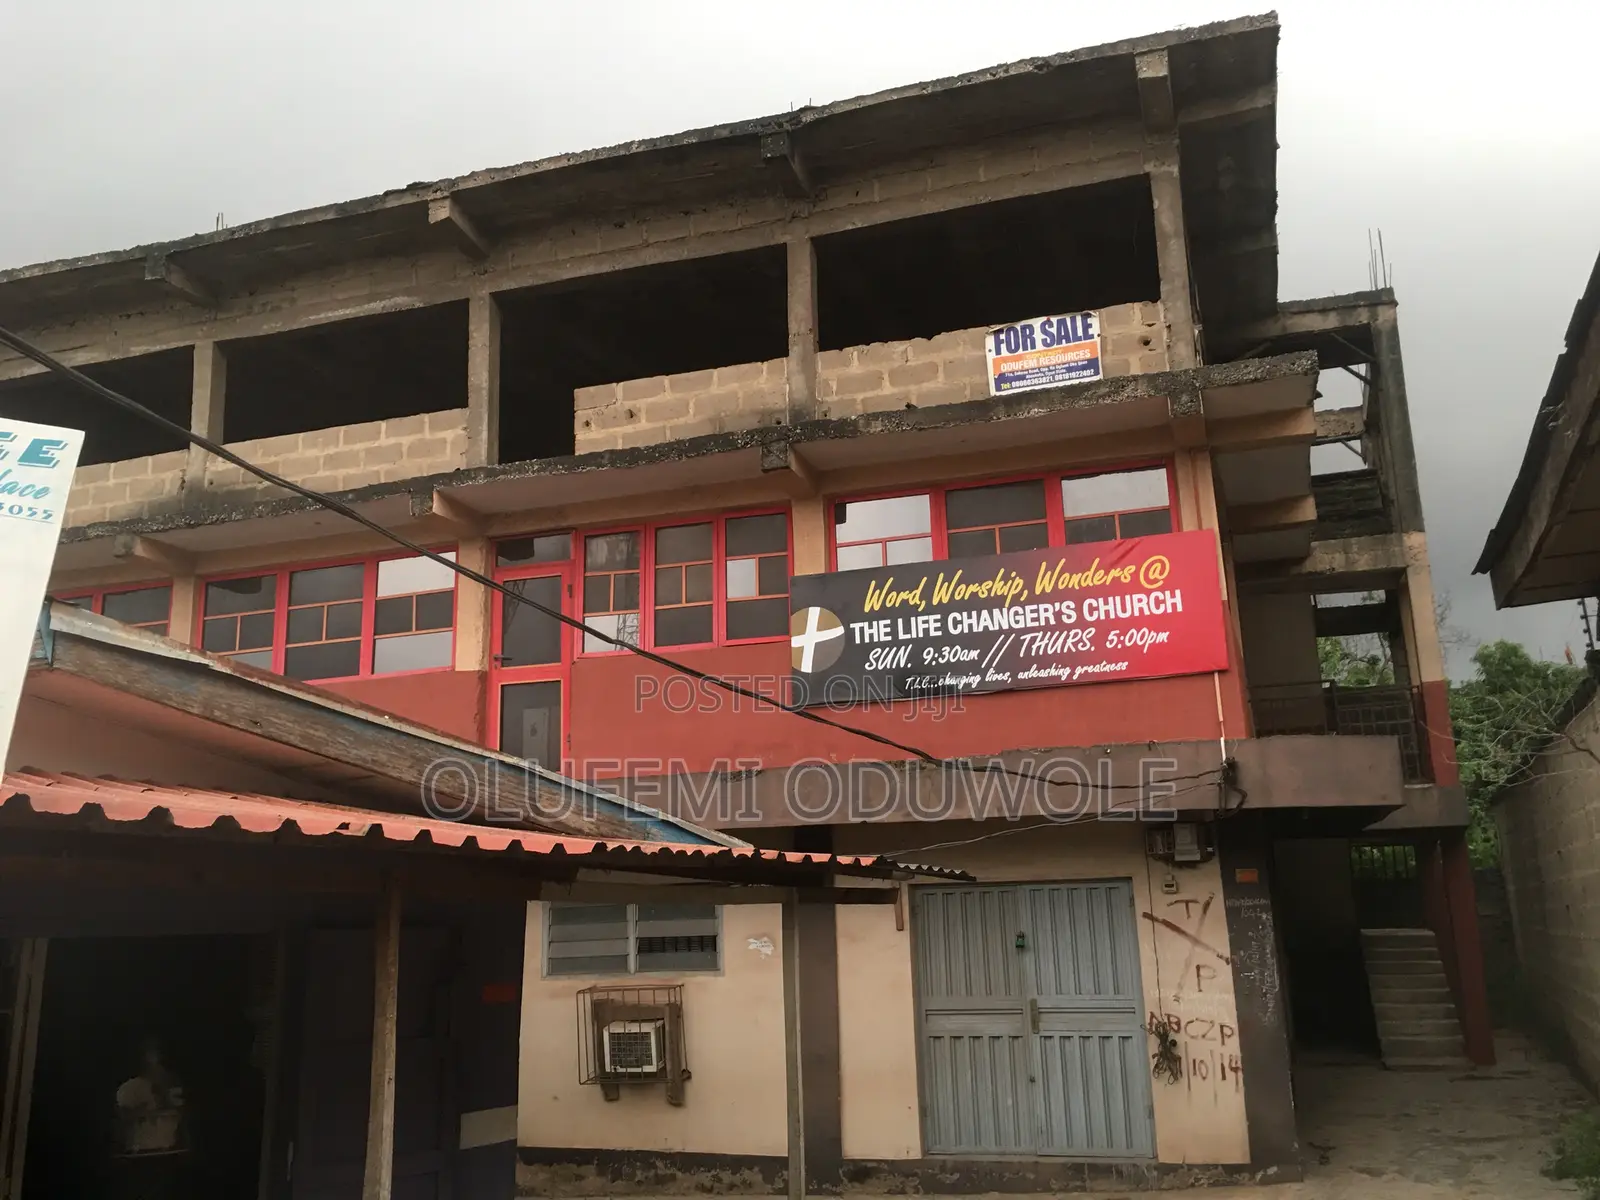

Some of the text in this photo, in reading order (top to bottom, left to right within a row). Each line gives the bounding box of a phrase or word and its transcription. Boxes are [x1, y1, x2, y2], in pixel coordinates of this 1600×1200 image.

[994, 315, 1095, 356] FOR SALE
[1001, 358, 1037, 372] ODUFEM
[1040, 349, 1091, 367] RESOURCES
[864, 555, 1170, 612] Word, Worship, Wonders @
[850, 589, 1182, 644] THE LIFE CHANGER'S CHURCH
[864, 644, 912, 671] SUN.
[922, 645, 980, 666] 9:30am
[1020, 627, 1096, 658] THURS.
[1106, 627, 1169, 654] 5:00pm
[985, 667, 1012, 684] lives,
[1018, 663, 1071, 681] unleashing
[1074, 660, 1128, 680] greatness
